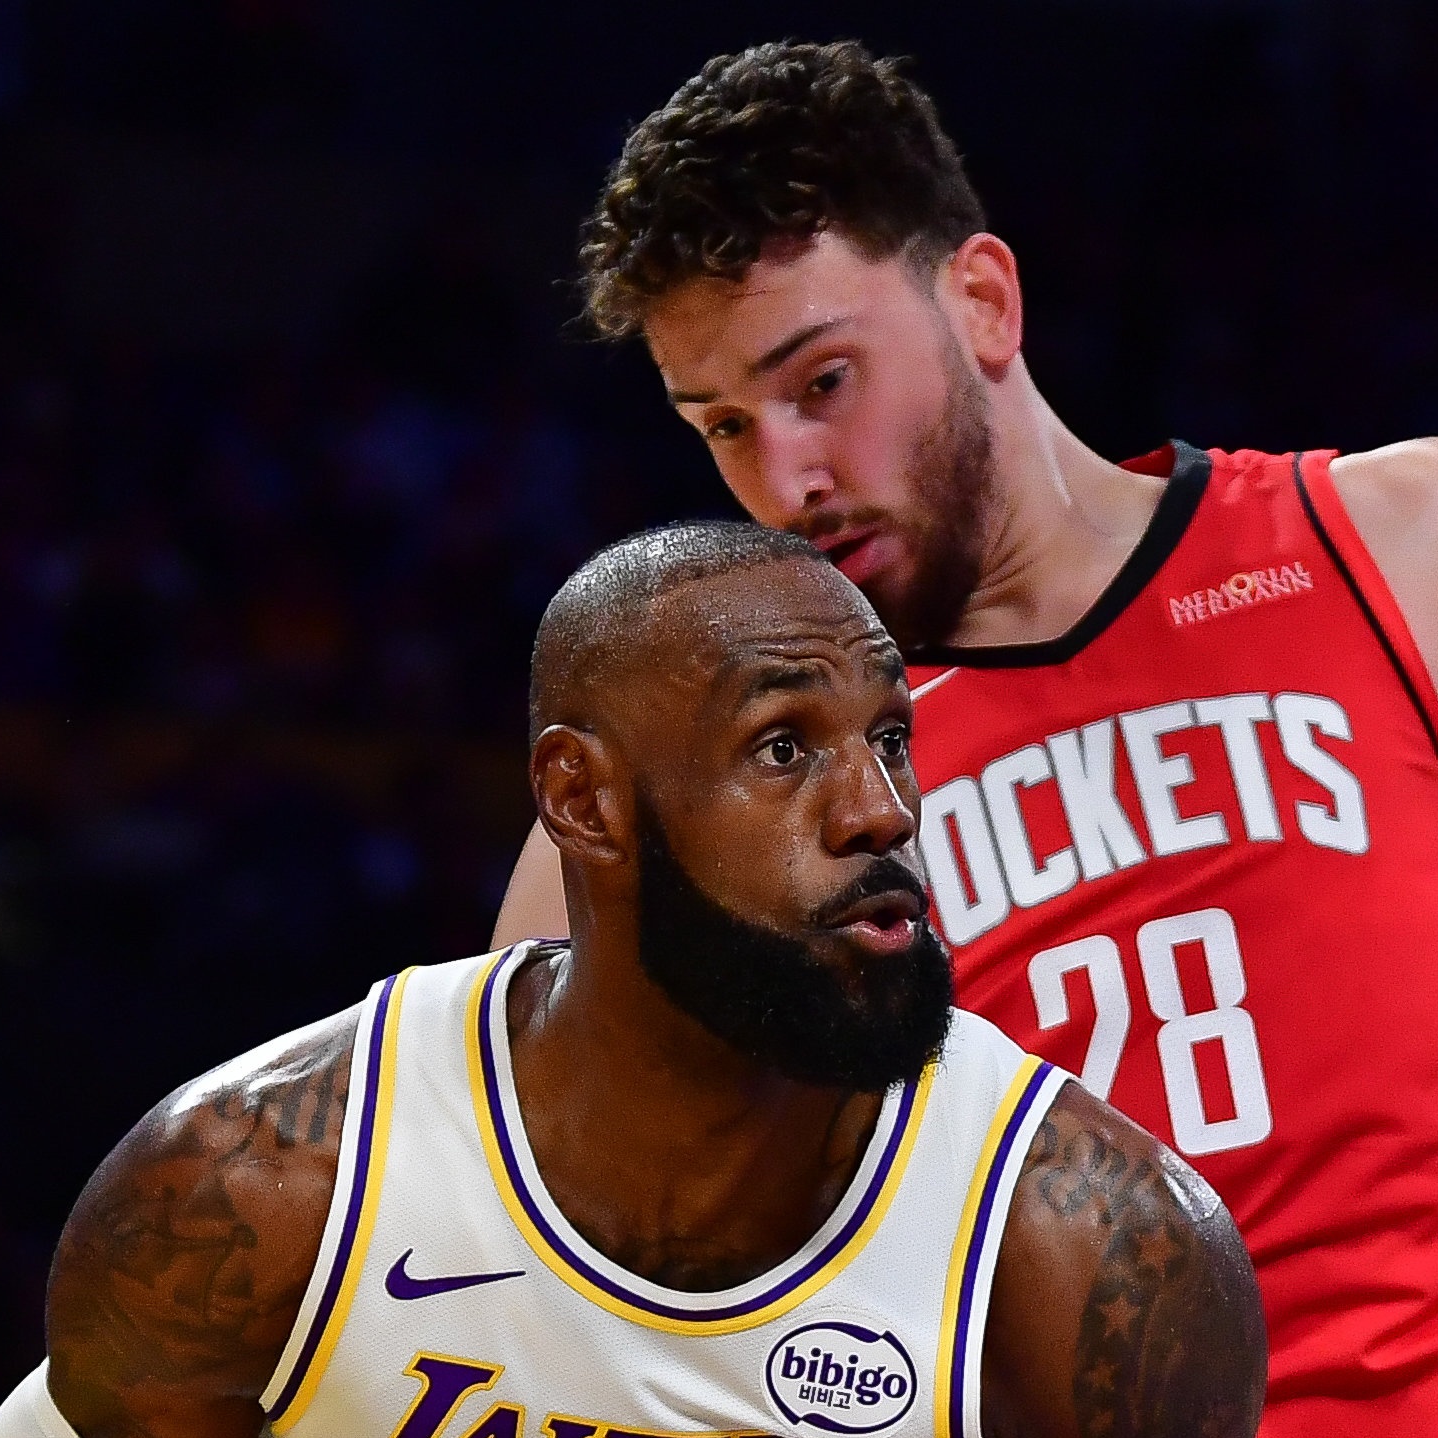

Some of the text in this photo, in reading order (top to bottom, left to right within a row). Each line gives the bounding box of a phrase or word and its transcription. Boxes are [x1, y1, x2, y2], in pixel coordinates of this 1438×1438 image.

[1168, 561, 1311, 614] MEMORIAL
[919, 691, 1370, 946] OCKETS
[1027, 907, 1273, 1155] 28
[781, 1345, 908, 1406] bibigo
[798, 1384, 851, 1410] 비비고
